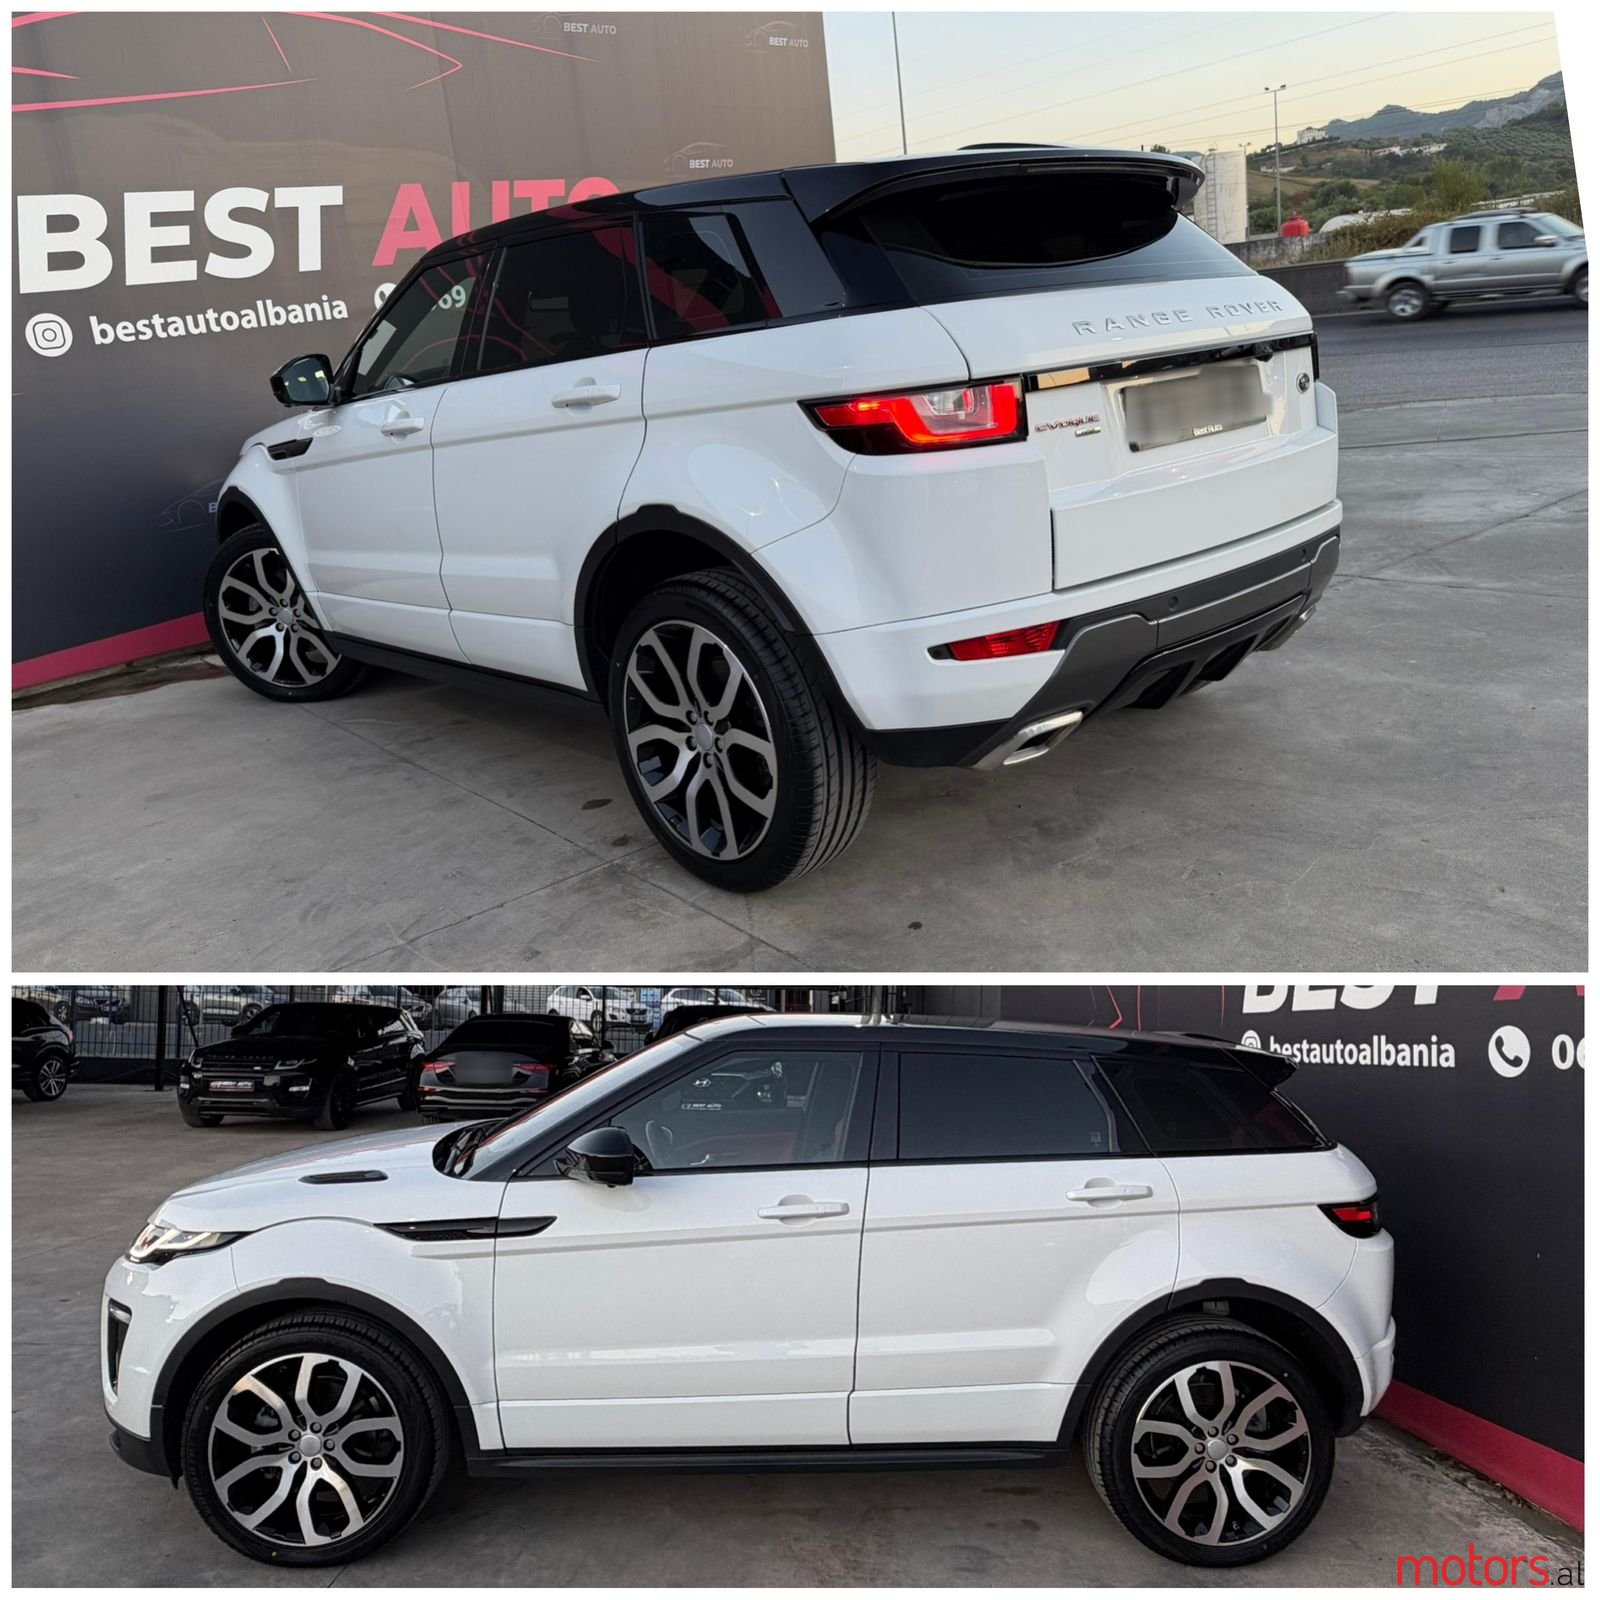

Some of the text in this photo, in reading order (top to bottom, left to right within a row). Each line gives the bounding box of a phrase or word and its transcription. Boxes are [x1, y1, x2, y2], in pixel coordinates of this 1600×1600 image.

[563, 22, 617, 35] BEST AUTO
[769, 36, 809, 48] BEST AUTO
[689, 158, 734, 169] BEST AUTO
[17, 185, 344, 294] BEST
[89, 294, 350, 346] bestautoalbania
[1071, 299, 1284, 336] RANGE ROVER
